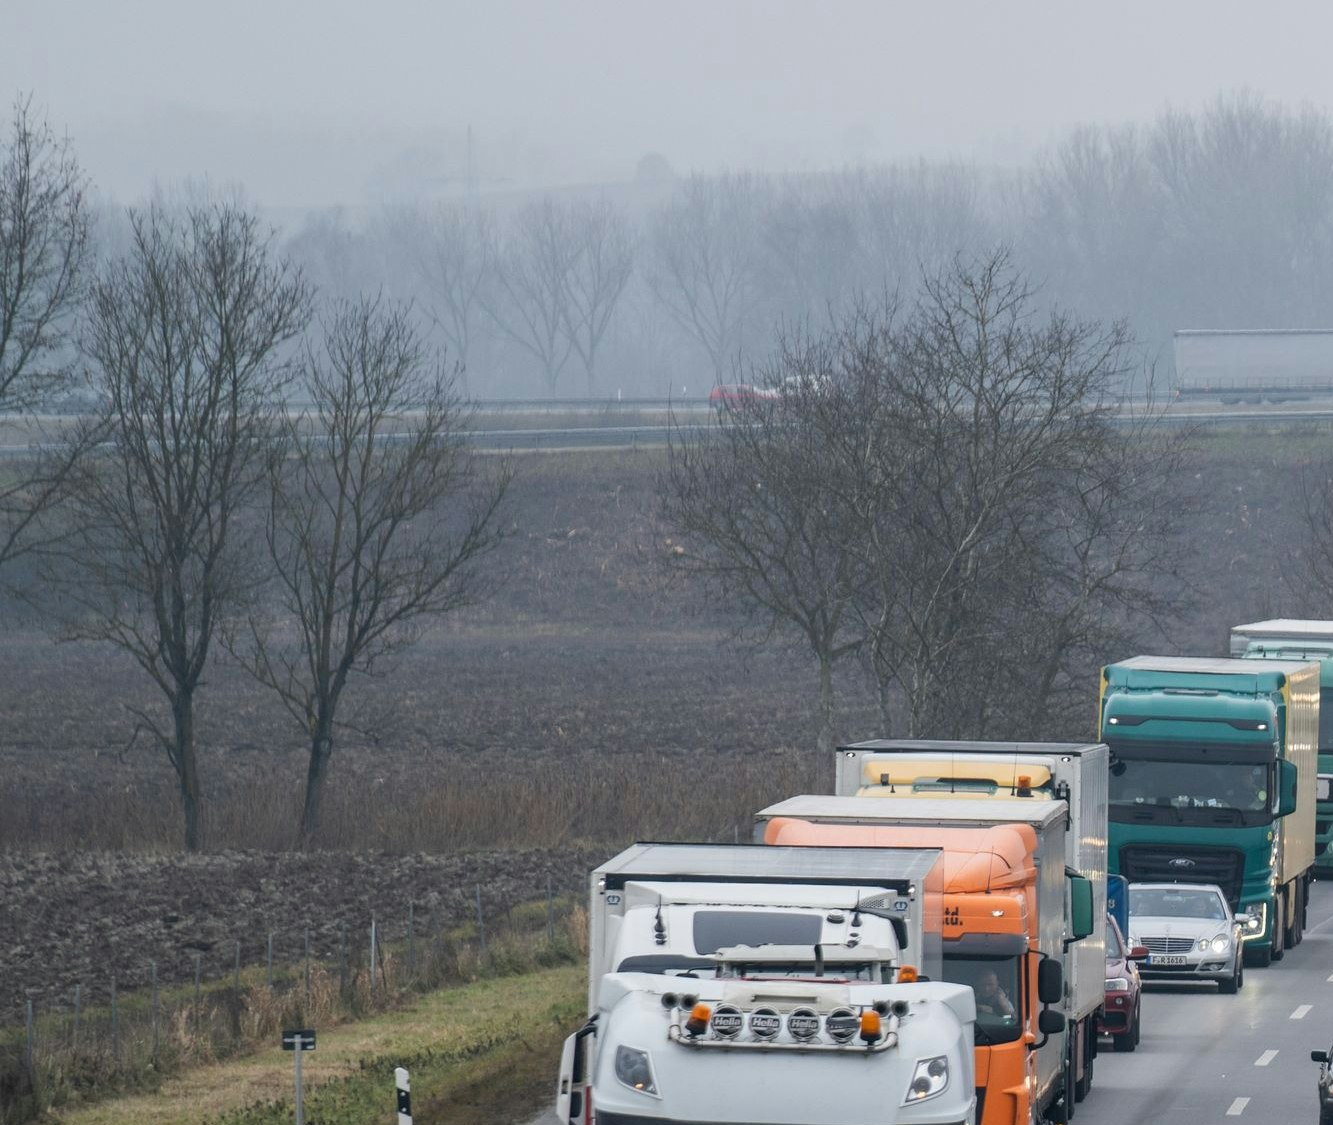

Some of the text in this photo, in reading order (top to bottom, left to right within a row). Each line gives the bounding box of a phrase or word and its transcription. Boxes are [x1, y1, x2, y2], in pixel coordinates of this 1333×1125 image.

[943, 907, 964, 926] td.
[714, 1017, 741, 1026] Hella
[752, 1017, 779, 1027] Hella
[791, 1018, 818, 1028] Hella
